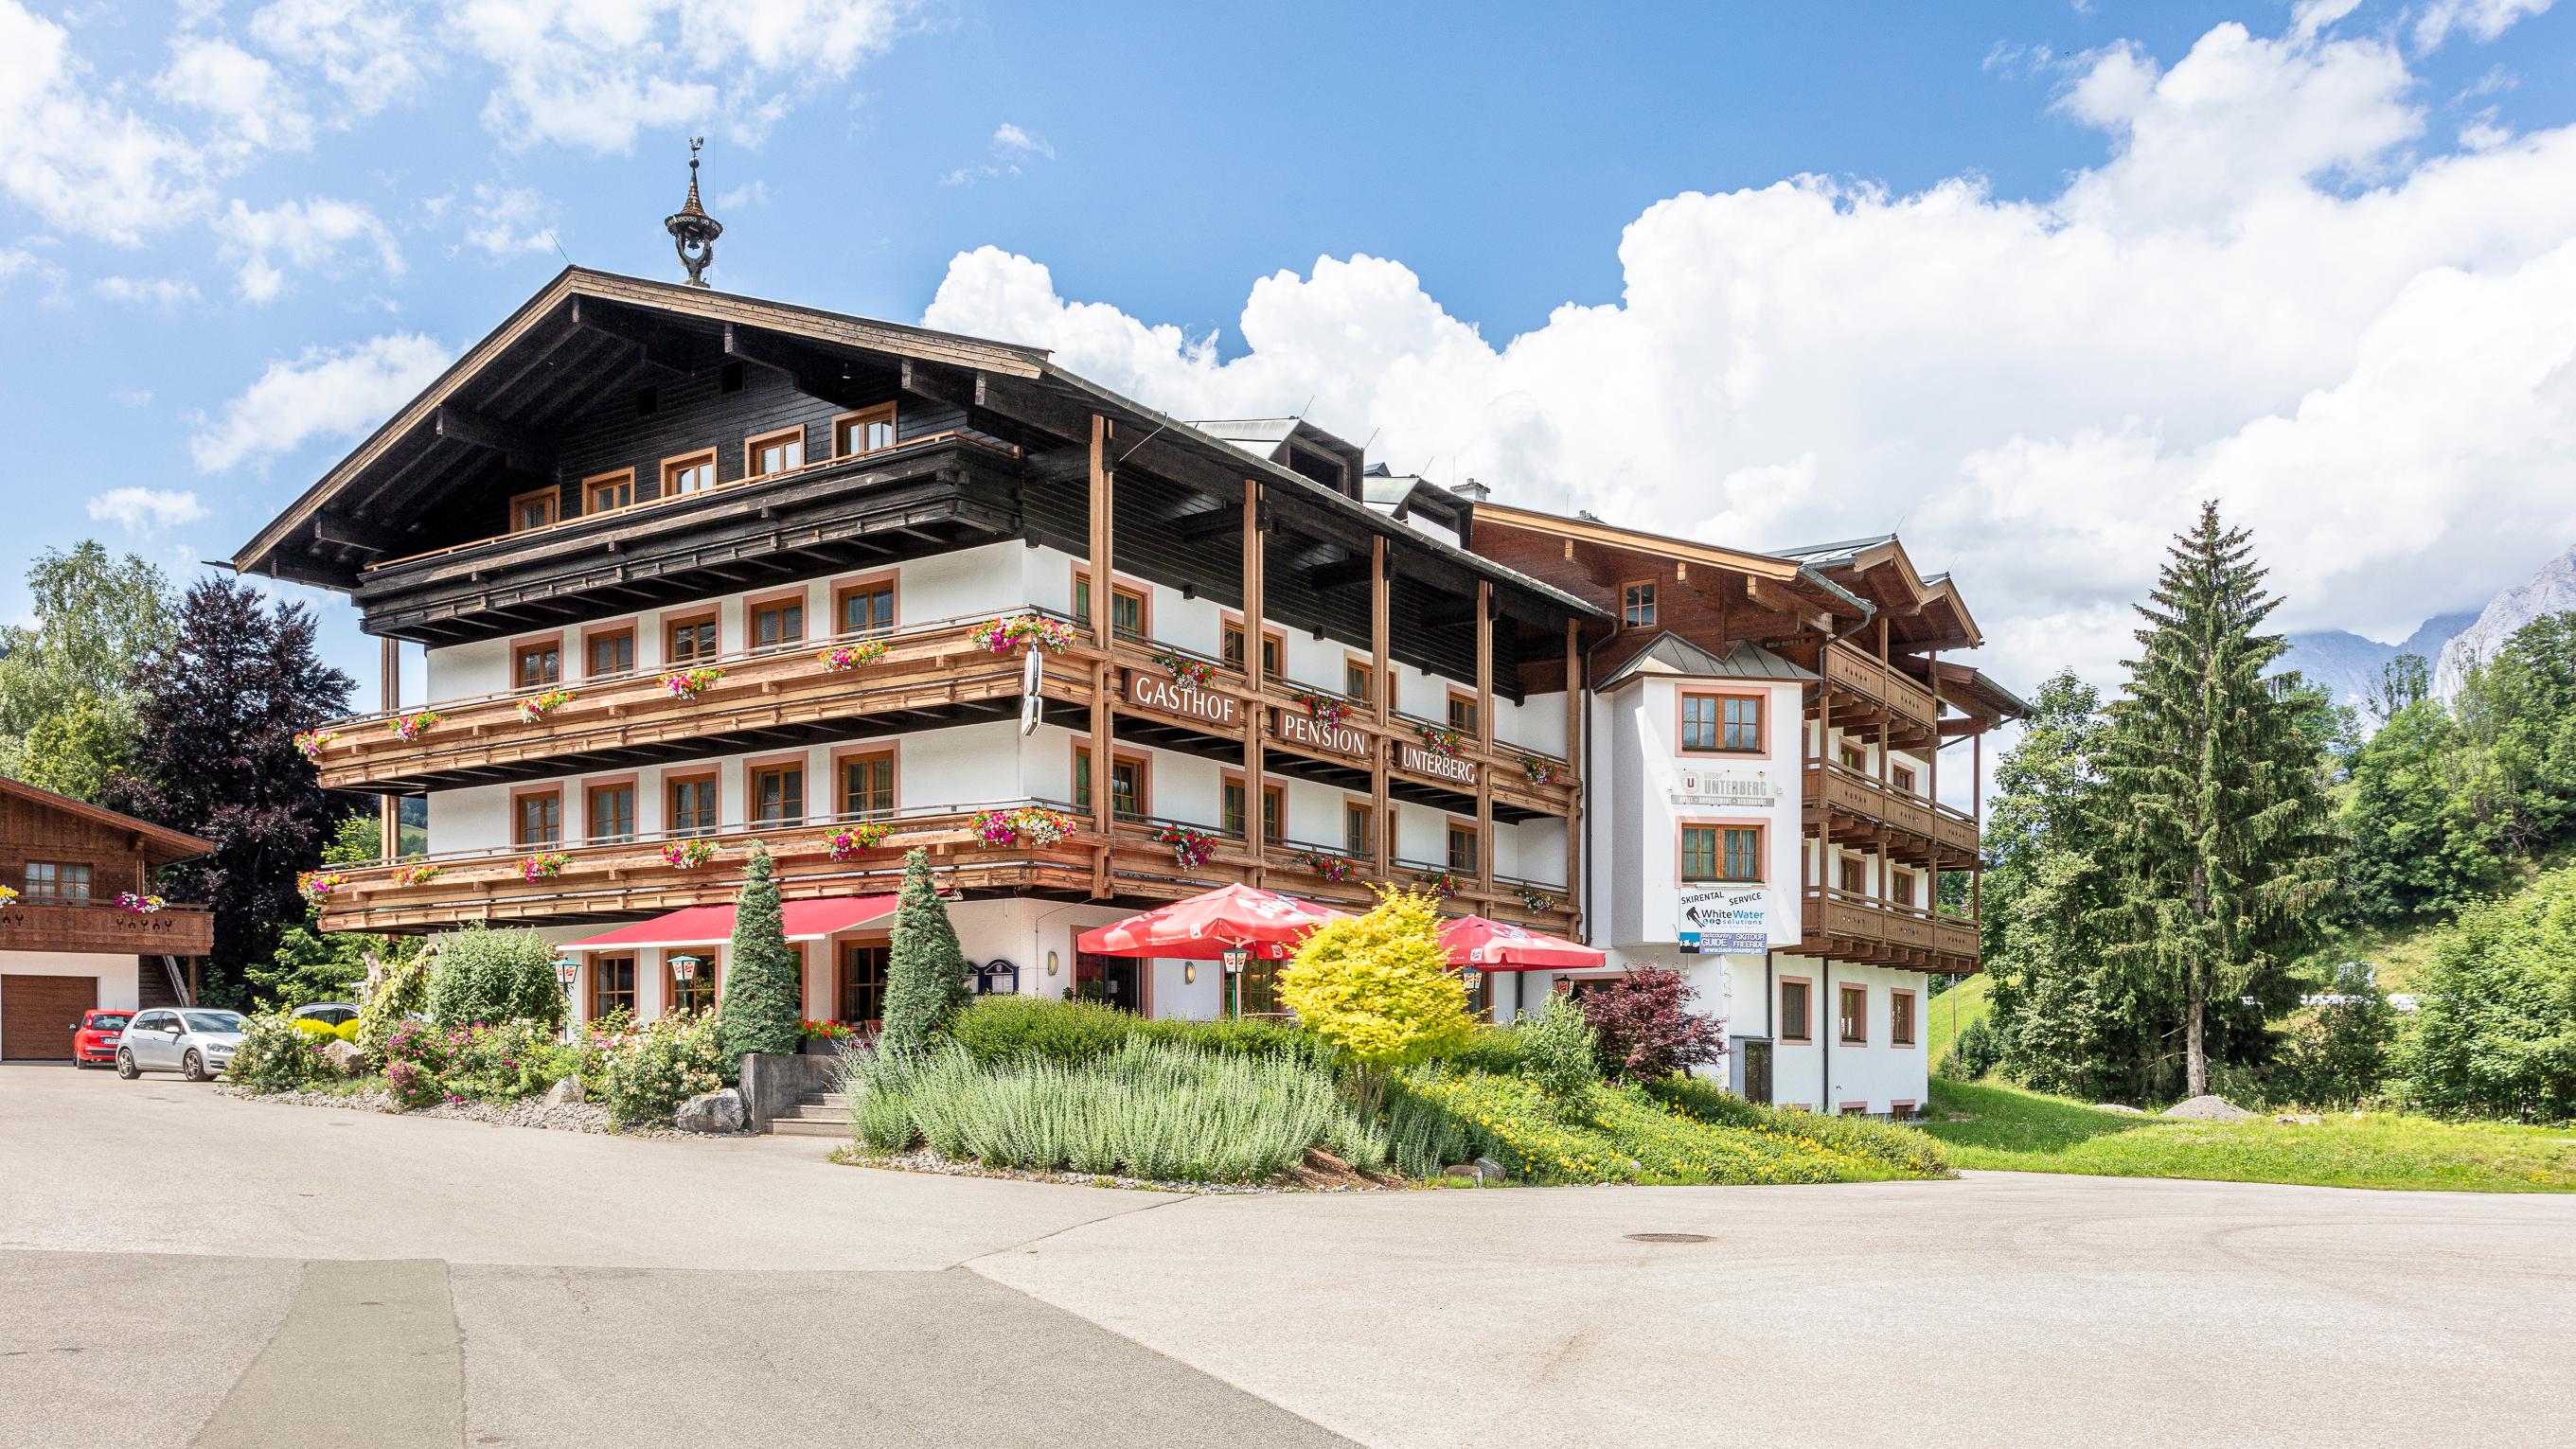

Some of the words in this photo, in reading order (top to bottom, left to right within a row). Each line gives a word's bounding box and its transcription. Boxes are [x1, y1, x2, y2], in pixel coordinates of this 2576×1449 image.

[1136, 677, 1235, 721] GASTHOF
[1285, 715, 1365, 755] PENSION
[1403, 746, 1476, 784] UNTERBERG
[1704, 779, 1767, 796] UNTERBERG
[1681, 892, 1725, 904] SKIRENTAL
[1729, 892, 1762, 906] SERVICE
[1700, 939, 1728, 947] GUIDE
